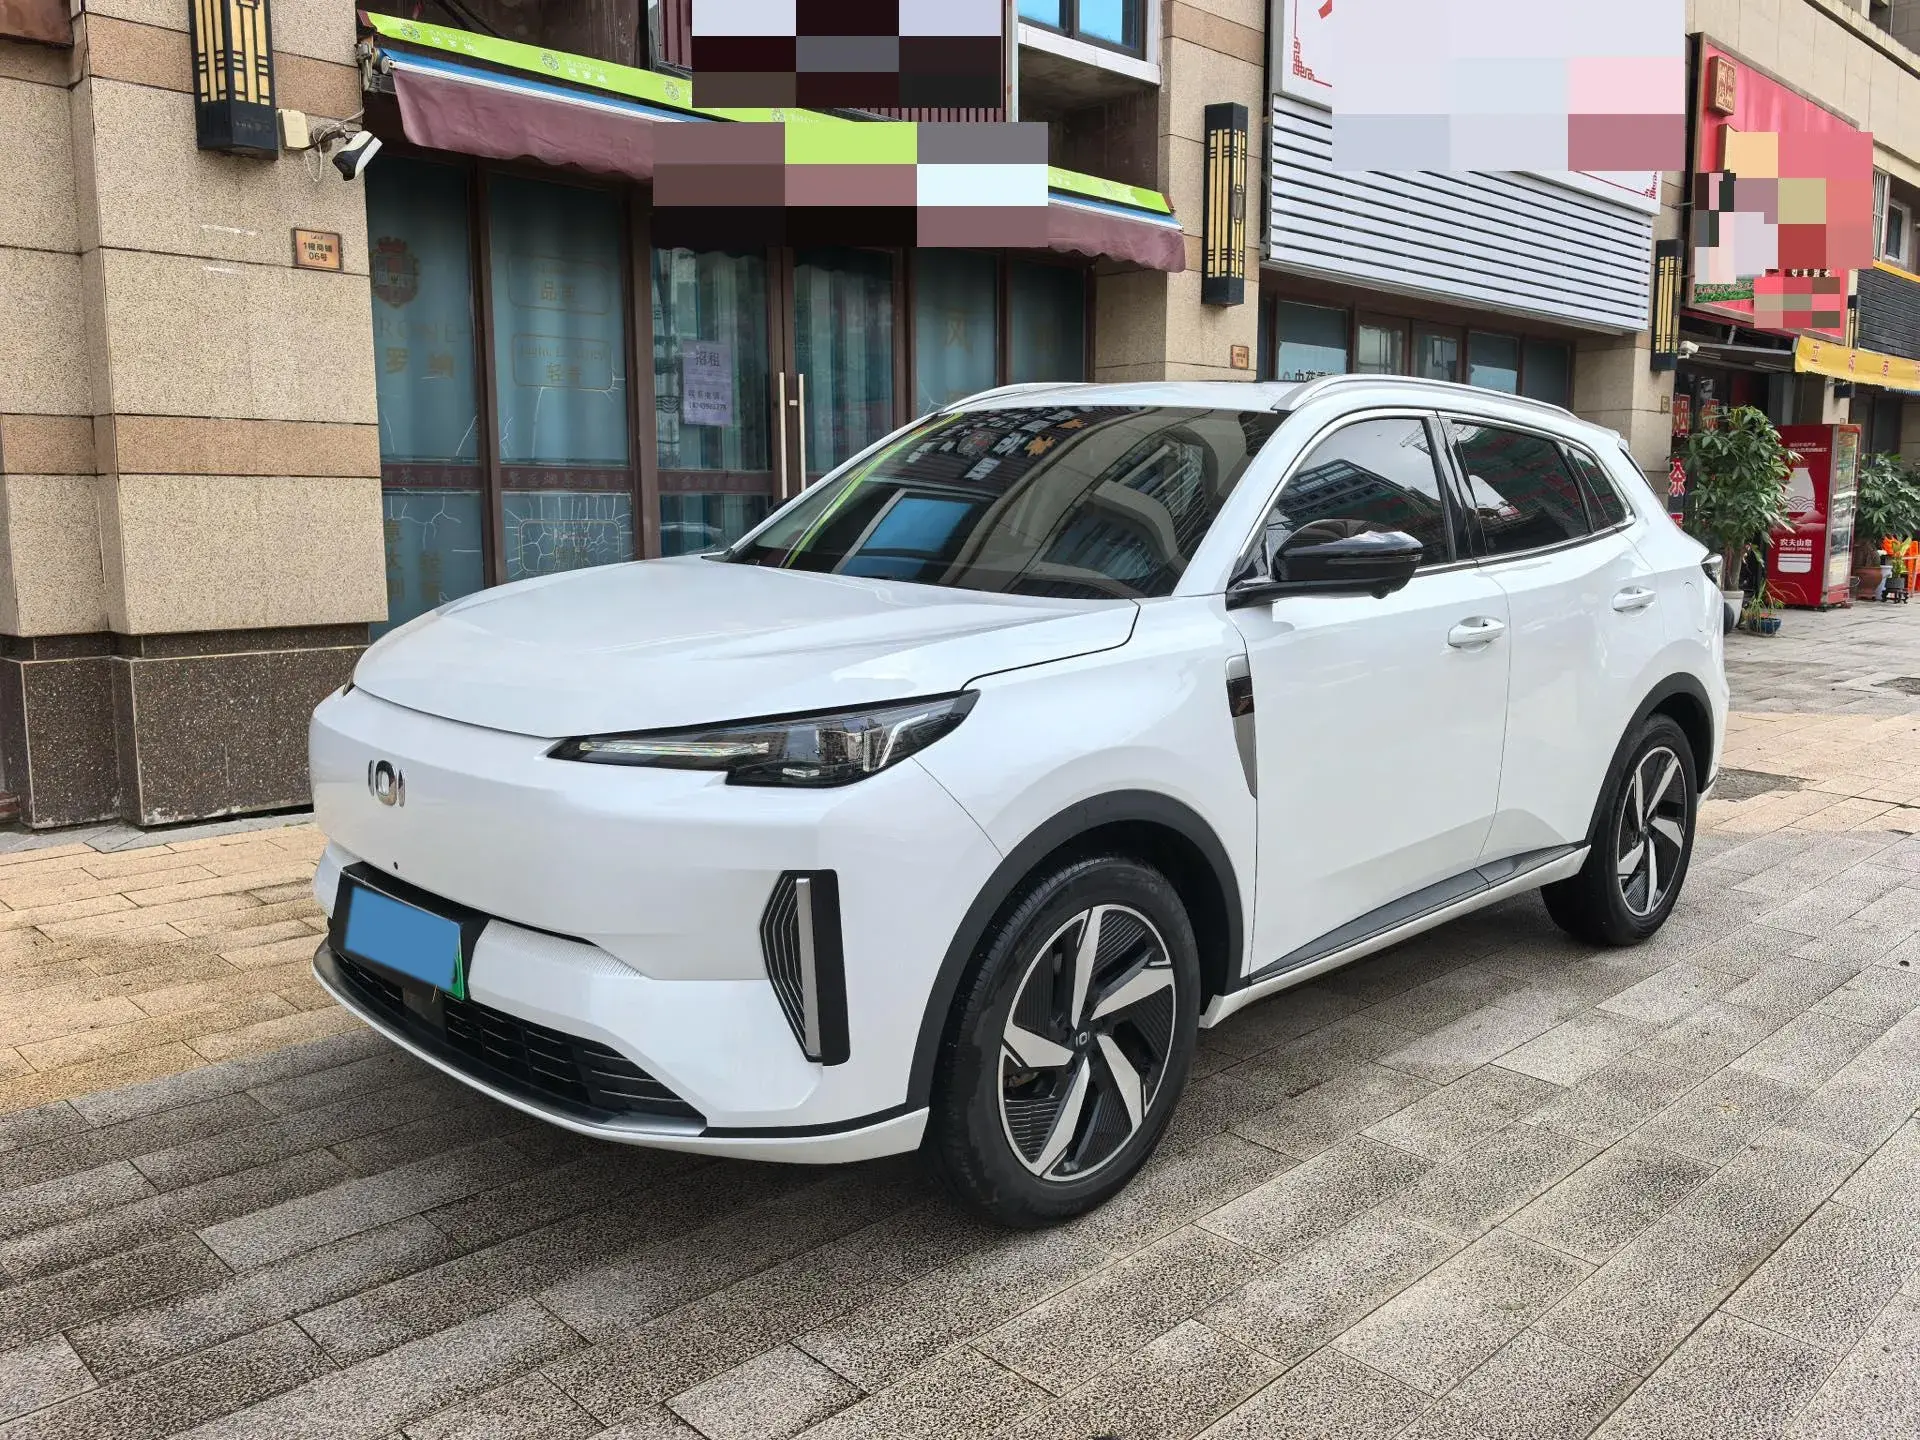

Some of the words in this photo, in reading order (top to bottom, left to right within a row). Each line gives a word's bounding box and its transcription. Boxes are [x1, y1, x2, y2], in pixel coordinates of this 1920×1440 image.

[308, 251, 328, 262] 06号
[1779, 538, 1812, 547] 农夫山泉
